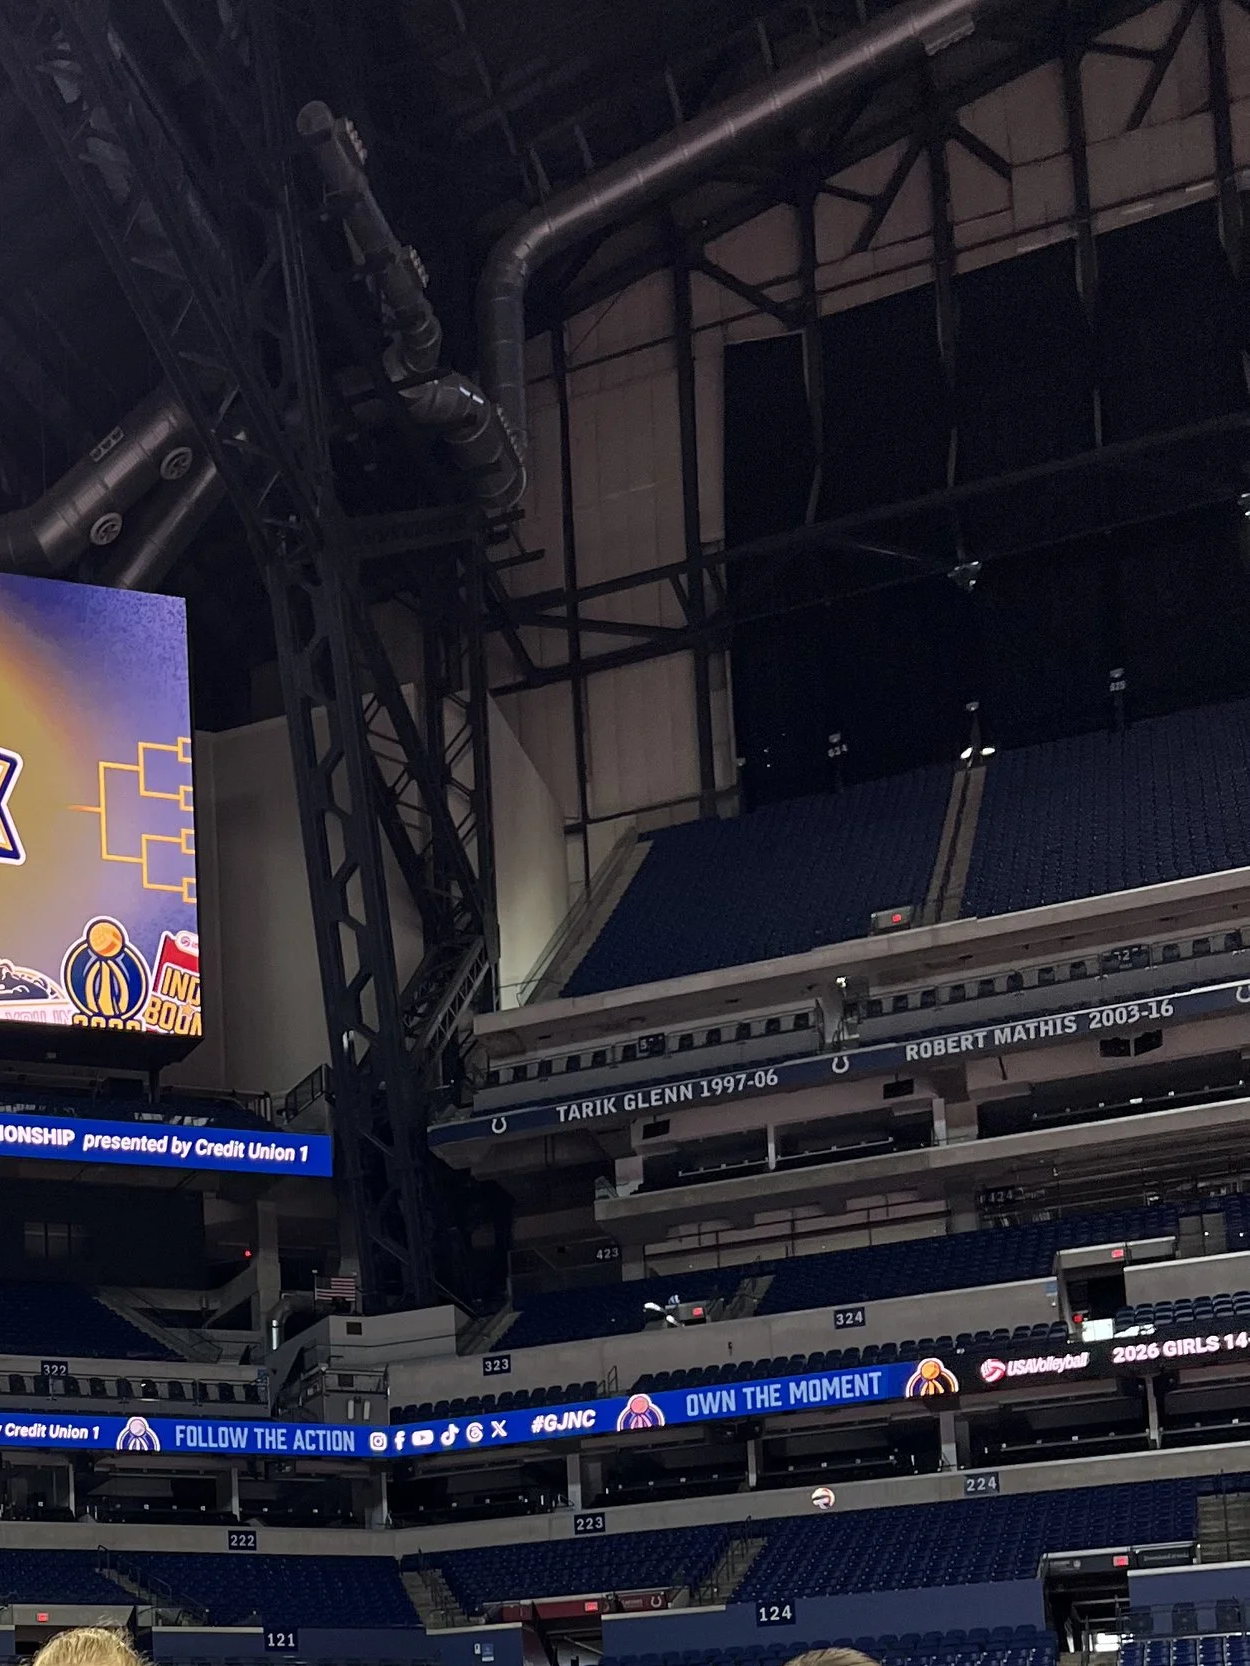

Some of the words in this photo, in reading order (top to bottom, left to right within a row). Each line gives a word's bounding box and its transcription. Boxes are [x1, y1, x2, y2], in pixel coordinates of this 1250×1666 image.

[905, 1031, 989, 1062] ROBERT
[993, 1015, 1078, 1046] MATHIS
[1088, 1001, 1174, 1030] 2003-16
[556, 1098, 617, 1123] TARIK
[622, 1083, 694, 1112] GLENN
[699, 1068, 779, 1099] 1997-06
[82, 1131, 168, 1154] presented
[171, 1136, 193, 1157] by
[195, 1139, 245, 1159] Credit
[248, 1143, 295, 1162] Union
[299, 1145, 309, 1163] 1
[595, 1246, 620, 1260] 423
[835, 1311, 864, 1326] 324
[1112, 1344, 1160, 1364] 2026
[1162, 1335, 1220, 1358] GIRLS
[43, 1364, 68, 1377] 322
[484, 1358, 510, 1372] 323
[686, 1387, 736, 1417] OWN
[743, 1383, 782, 1410] THE
[789, 1371, 882, 1405] MOMENT
[531, 1409, 596, 1434] #GJNC
[4, 1422, 47, 1440] Credit
[49, 1425, 89, 1441] Union
[92, 1425, 100, 1441] 1
[175, 1424, 248, 1449] FOLLOW
[254, 1427, 288, 1450] THE
[292, 1427, 355, 1452] ACTION
[966, 1476, 998, 1492] 224
[576, 1516, 604, 1531] 223
[230, 1534, 256, 1547] 222
[759, 1605, 792, 1621] 124
[267, 1632, 295, 1647] 121
